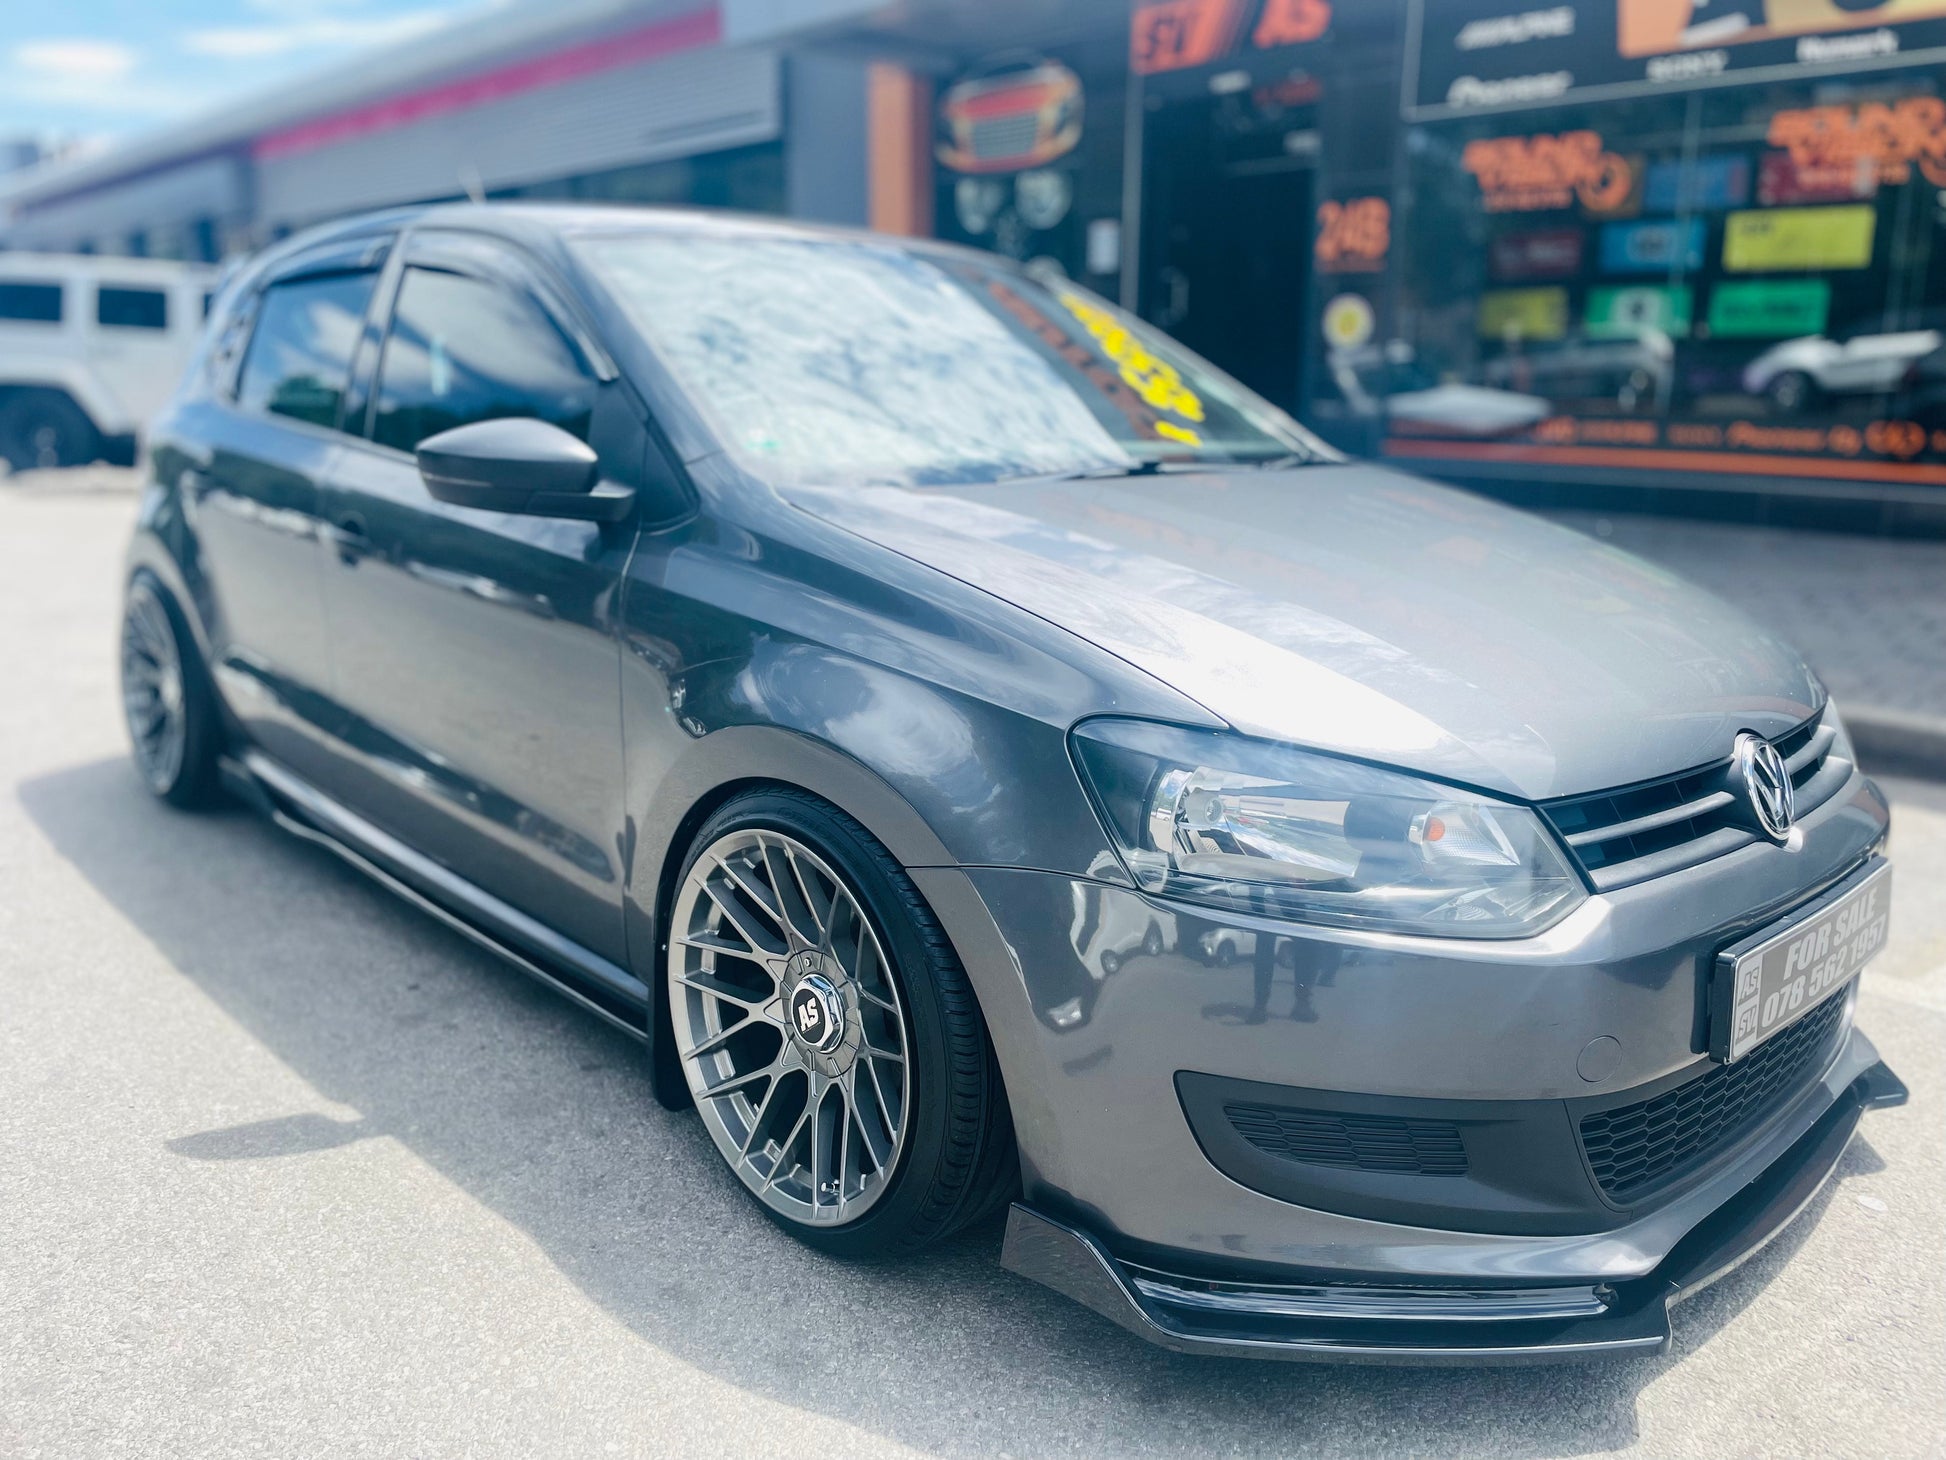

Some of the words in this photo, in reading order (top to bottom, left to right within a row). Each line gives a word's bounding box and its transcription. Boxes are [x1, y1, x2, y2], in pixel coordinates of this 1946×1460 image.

[1784, 922, 1831, 980] FOR
[1833, 886, 1878, 946] SALE
[798, 997, 819, 1032] AS
[1761, 975, 1806, 1028] 078
[1808, 946, 1848, 997] 562
